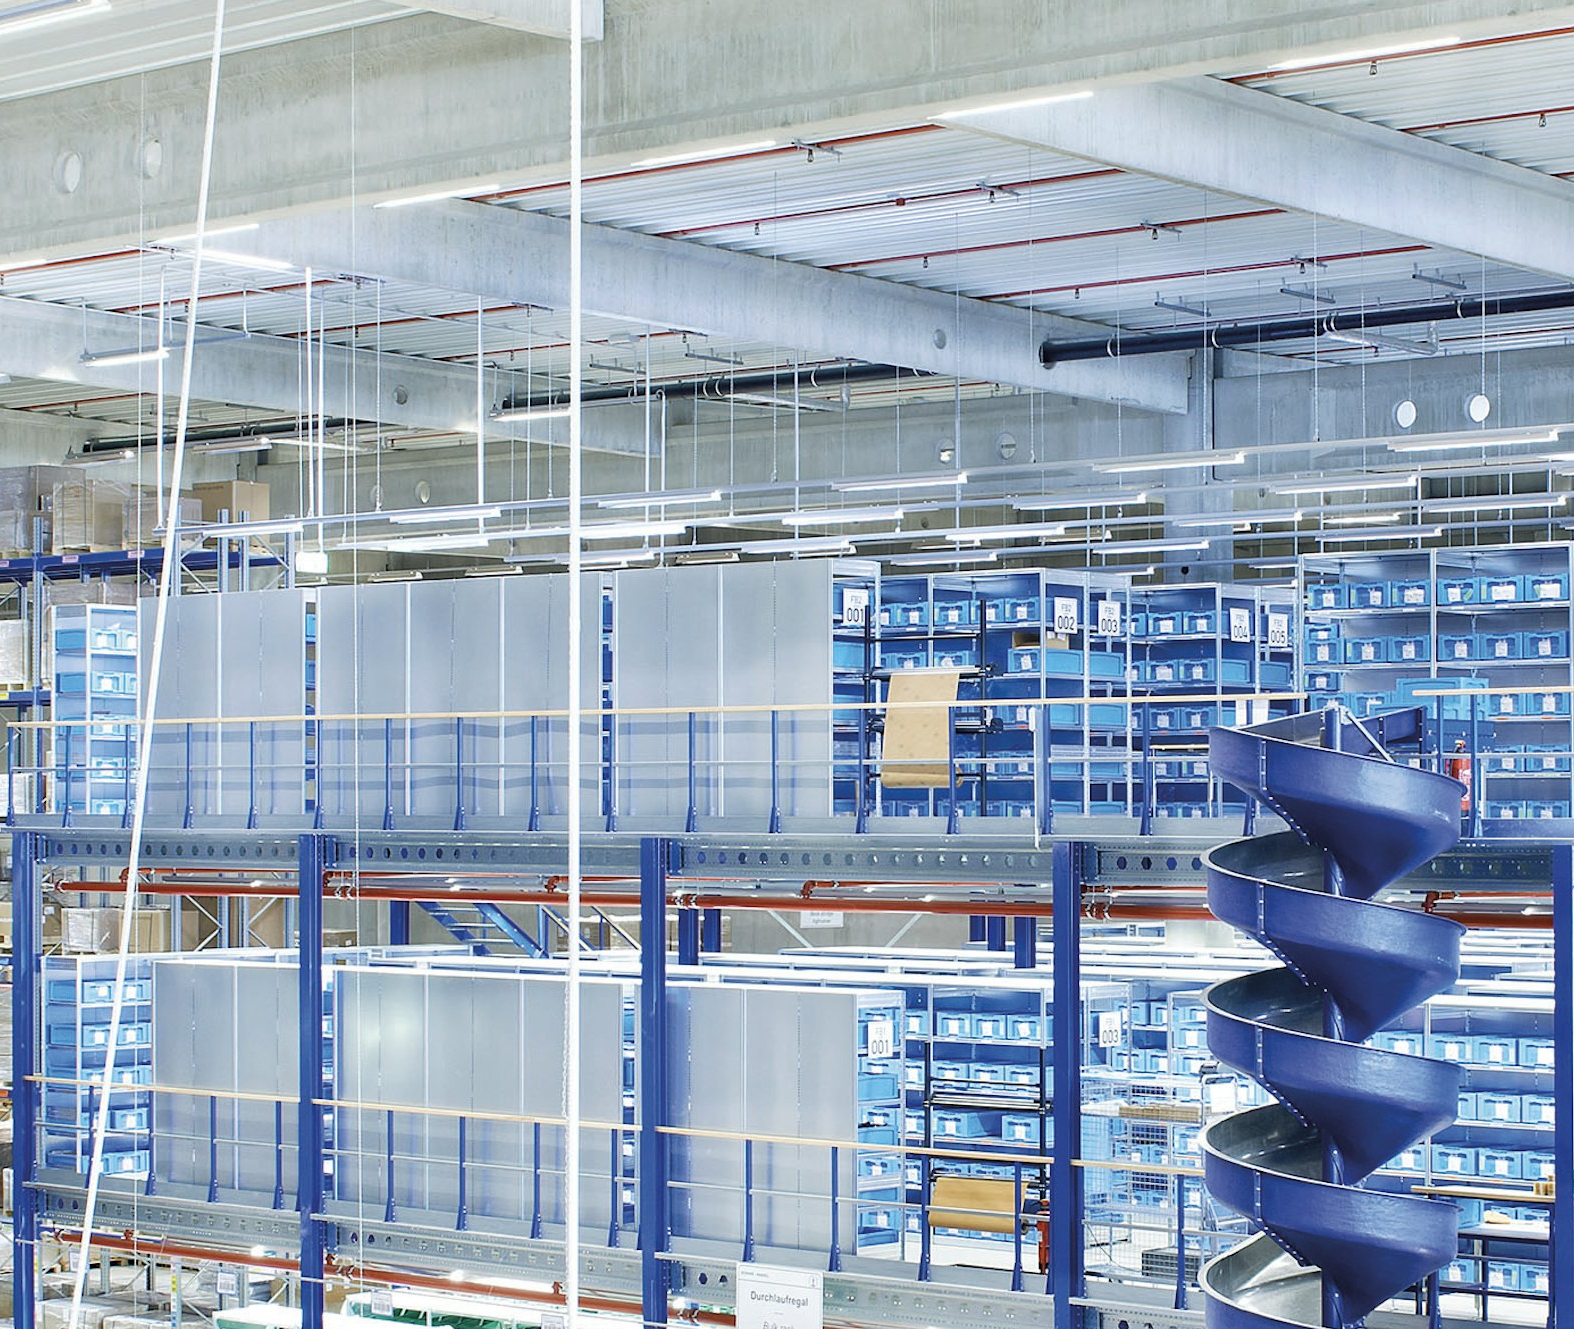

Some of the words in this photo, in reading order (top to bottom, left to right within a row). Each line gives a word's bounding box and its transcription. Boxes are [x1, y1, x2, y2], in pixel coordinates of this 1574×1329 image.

[846, 607, 865, 625] 001
[1057, 615, 1075, 631] 002
[871, 1040, 890, 1055] 001
[750, 1290, 809, 1308] Durchlaufregal
